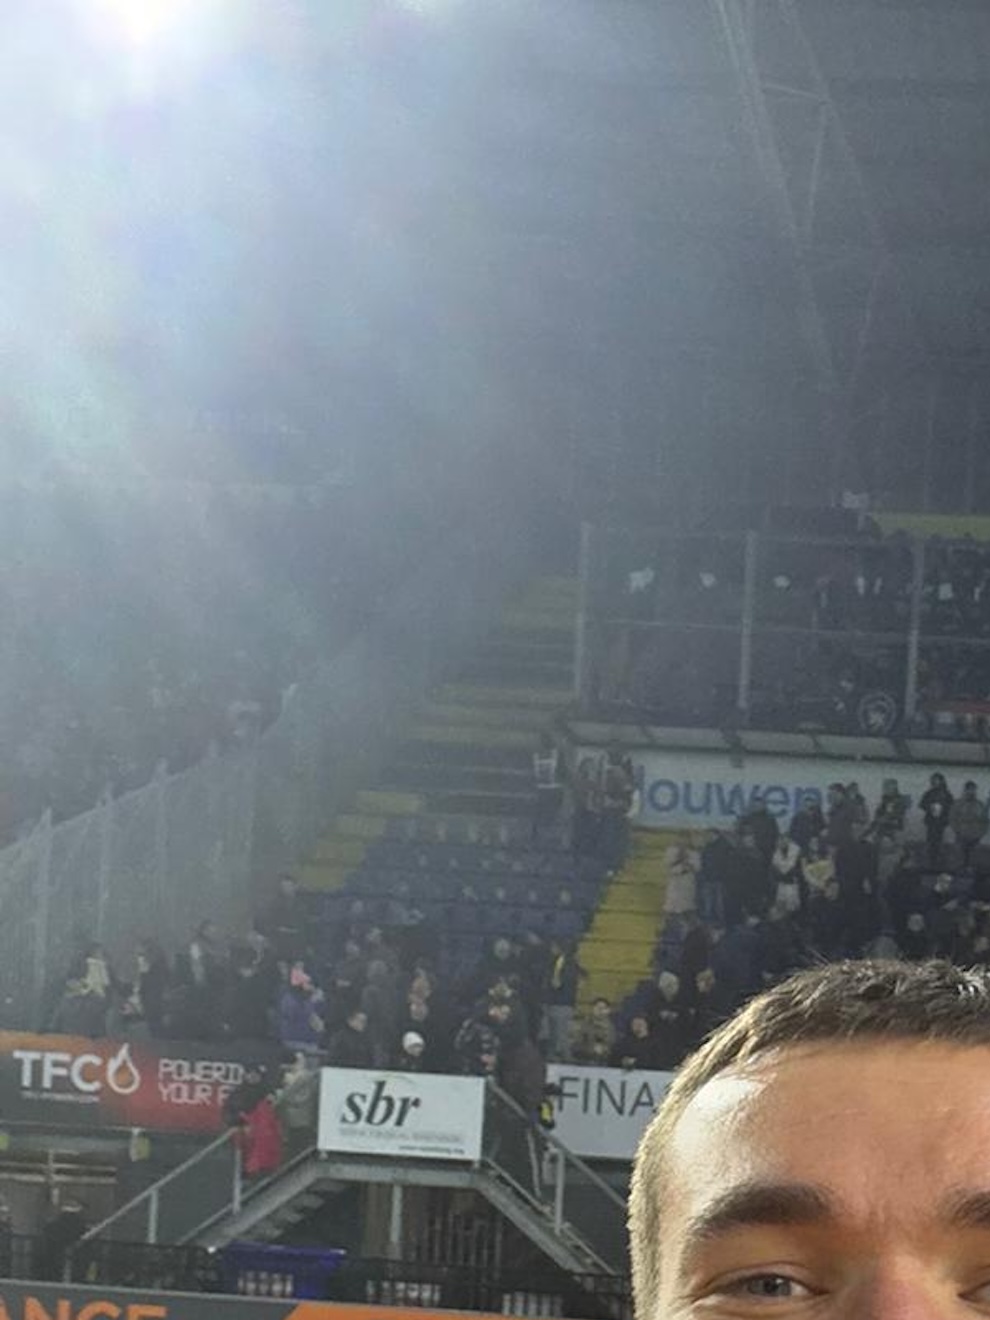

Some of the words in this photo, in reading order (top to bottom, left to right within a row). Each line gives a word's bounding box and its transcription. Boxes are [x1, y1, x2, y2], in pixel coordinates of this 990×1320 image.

[13, 1050, 102, 1093] TFC
[340, 1080, 422, 1126] sbr
[557, 1075, 657, 1117] FINA
